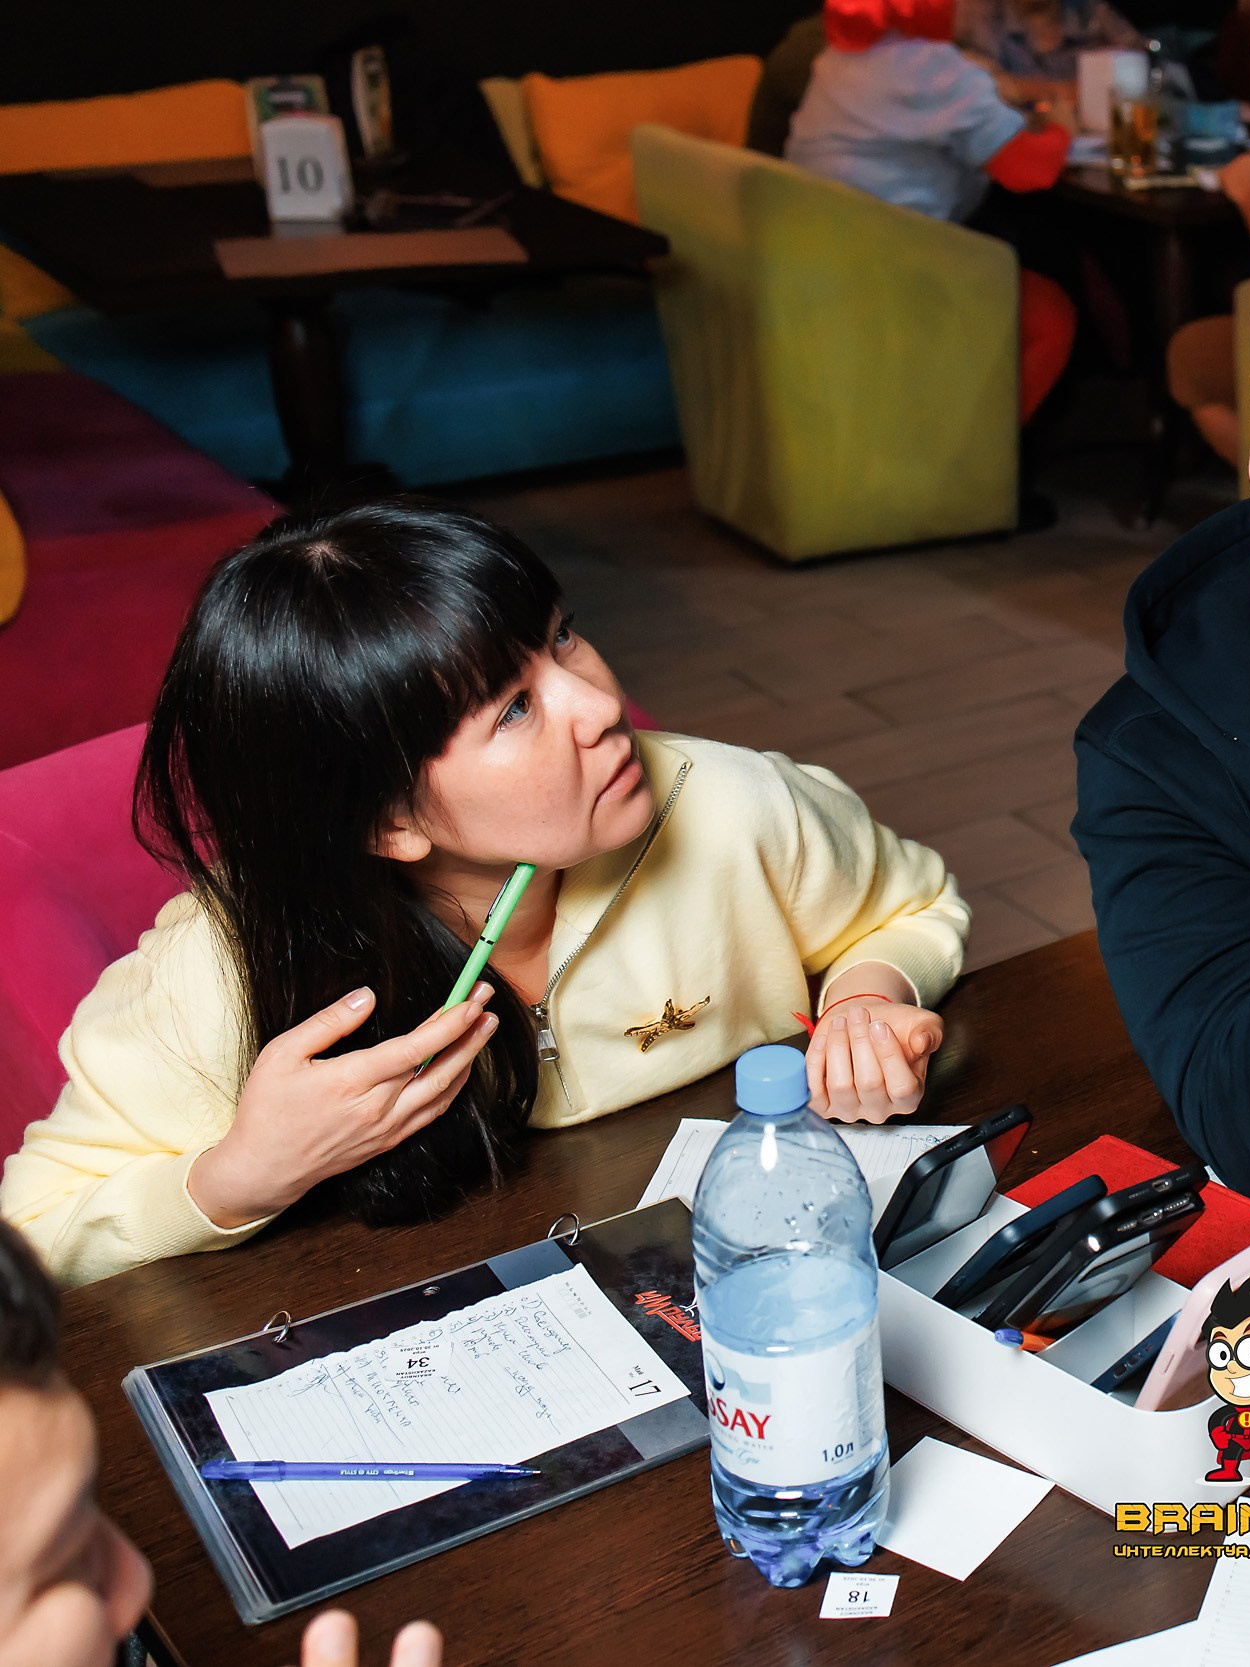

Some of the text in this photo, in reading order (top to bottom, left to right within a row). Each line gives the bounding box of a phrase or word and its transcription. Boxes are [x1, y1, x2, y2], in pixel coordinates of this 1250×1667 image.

[276, 156, 324, 194] 10
[406, 1356, 430, 1369] 34
[628, 1379, 662, 1397] 17
[848, 1590, 871, 1603] 18
